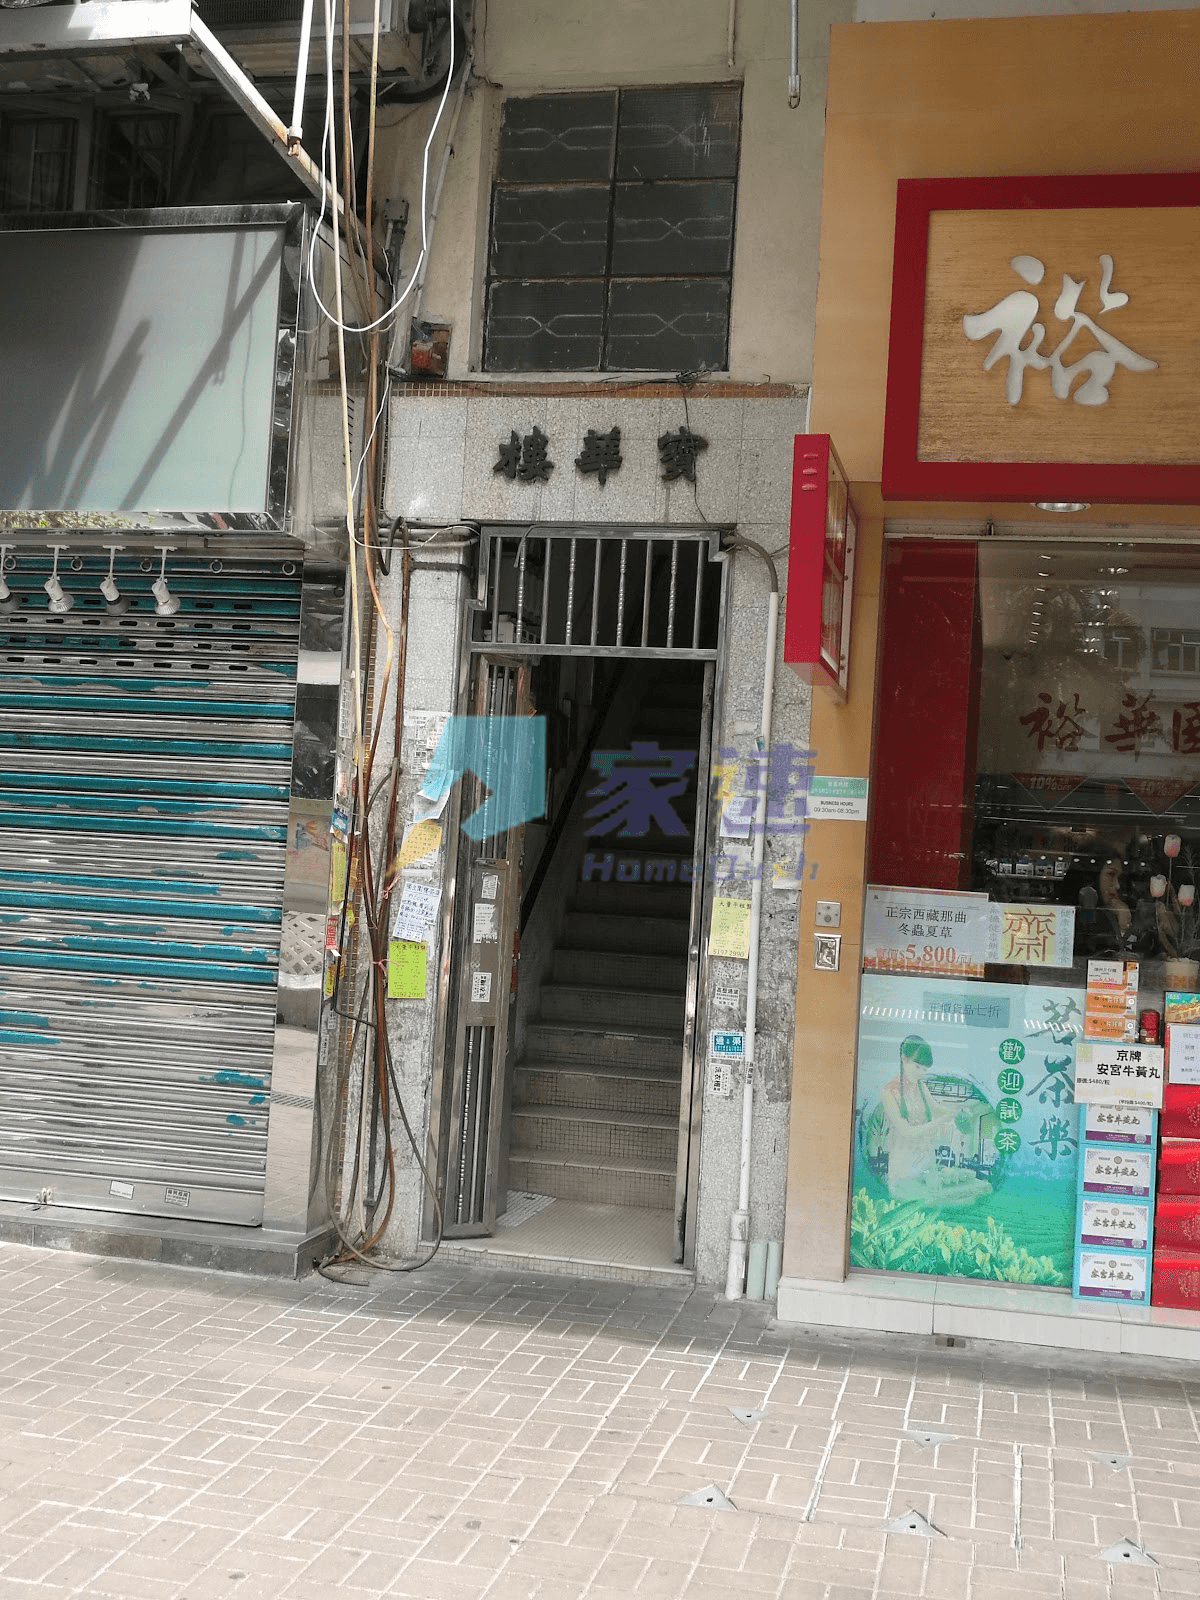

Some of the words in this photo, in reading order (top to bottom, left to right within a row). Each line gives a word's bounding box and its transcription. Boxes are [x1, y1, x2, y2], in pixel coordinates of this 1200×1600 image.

[963, 254, 1159, 406] 裕
[885, 905, 967, 924] 正宗西藏那曲
[898, 923, 953, 939] 冬蟲夏草
[1003, 907, 1056, 962] 齋
[1116, 1050, 1142, 1062] 京牌
[1096, 1064, 1161, 1079] 安宮牛黃丸
[996, 1040, 1023, 1152] 歡迎試茶
